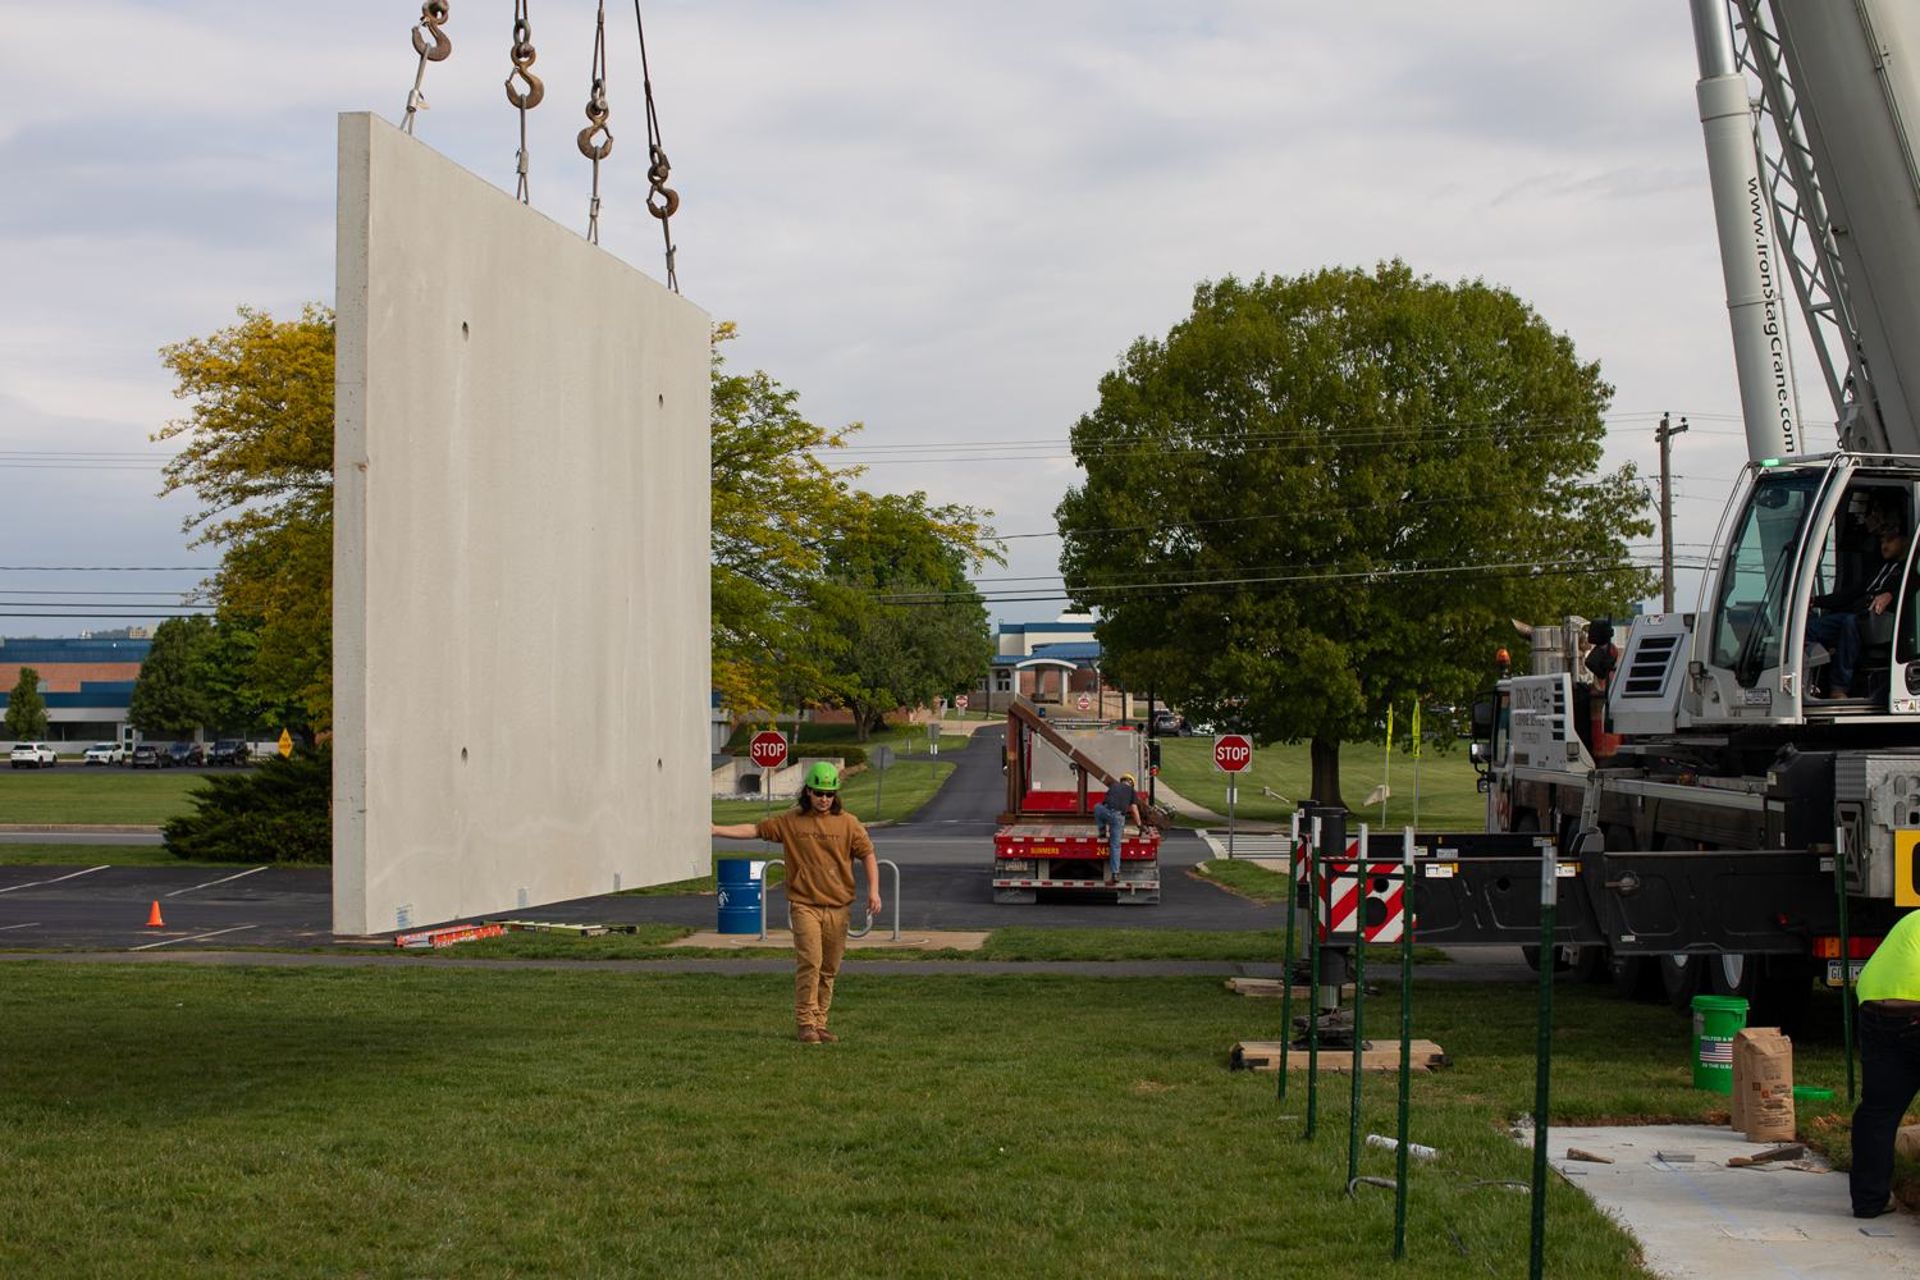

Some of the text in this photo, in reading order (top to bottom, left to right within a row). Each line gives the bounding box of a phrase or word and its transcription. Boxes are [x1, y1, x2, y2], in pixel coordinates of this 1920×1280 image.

[1747, 176, 1795, 453] www.IronStagCrane.com
[753, 743, 786, 757] STOP
[1216, 746, 1249, 760] STOP
